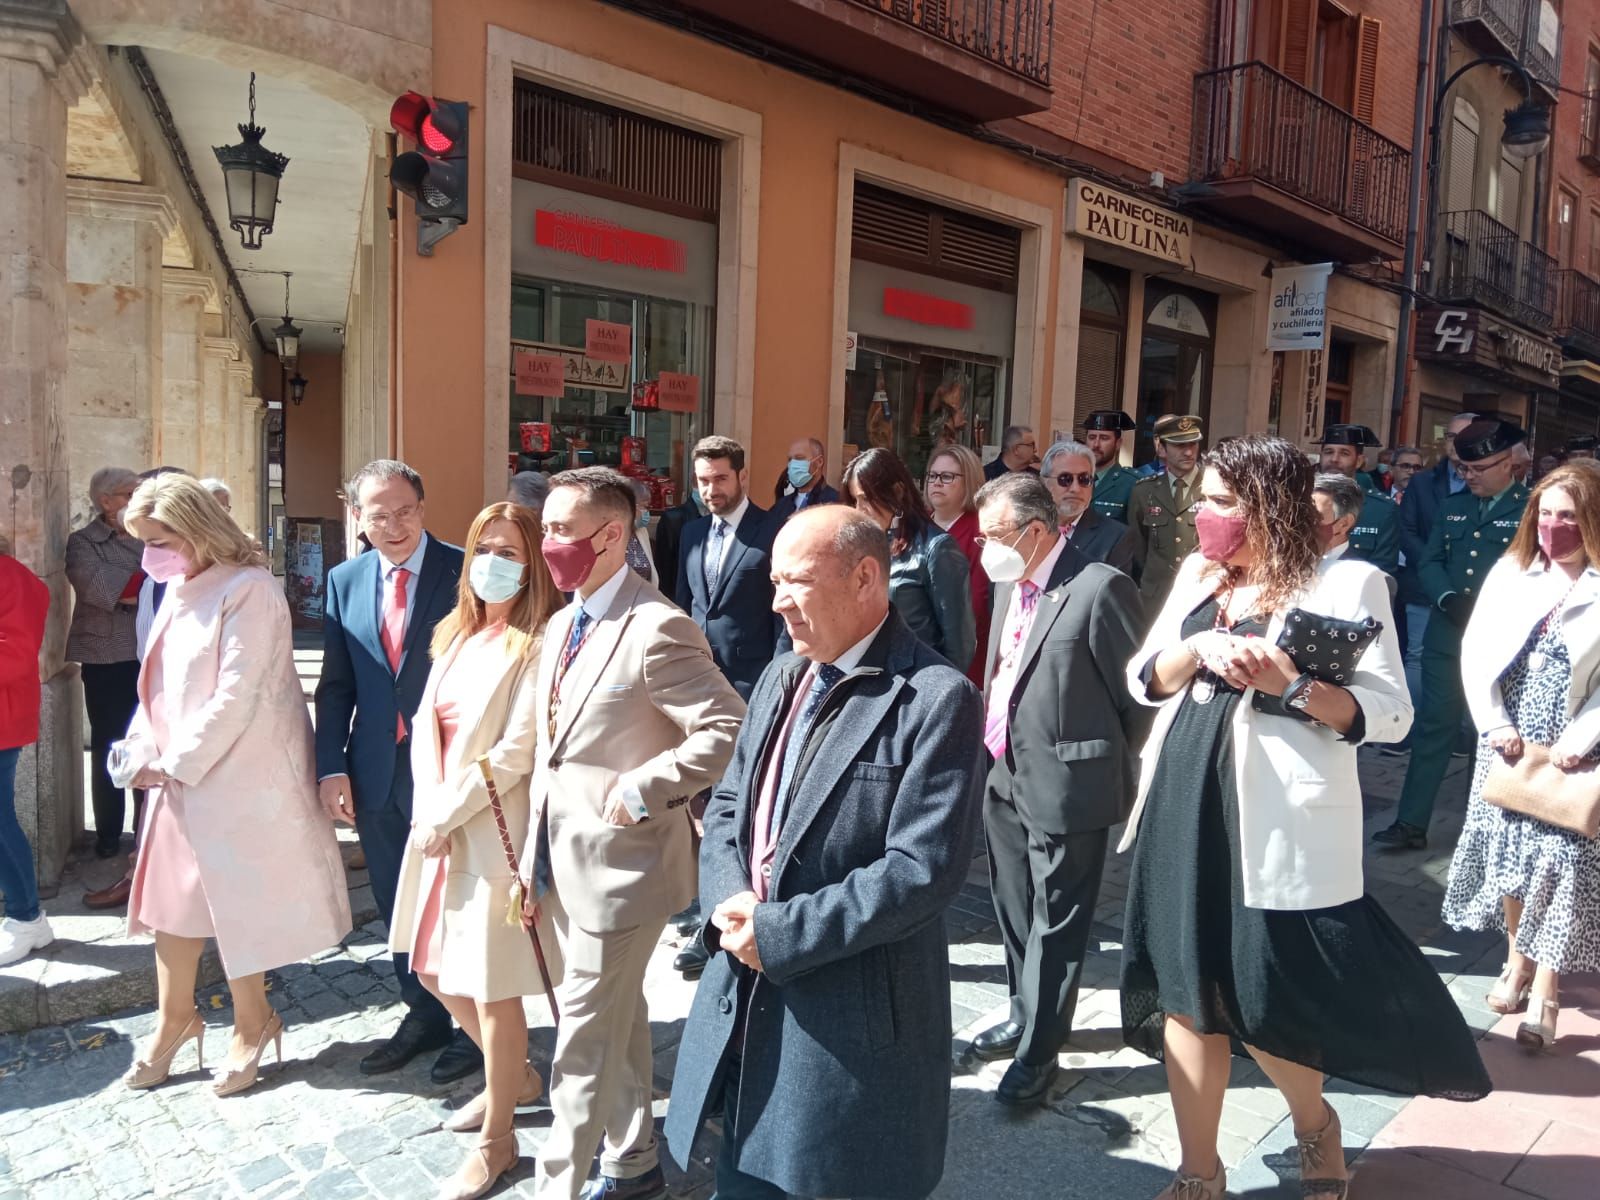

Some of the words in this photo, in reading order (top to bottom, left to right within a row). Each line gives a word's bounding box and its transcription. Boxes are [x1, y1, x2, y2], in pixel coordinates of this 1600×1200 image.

[1080, 186, 1189, 237] CARNECERIA
[1086, 209, 1182, 259] PAULINA
[553, 224, 658, 271] PAULINA
[1290, 307, 1324, 317] afilados
[1272, 322, 1278, 330] y
[597, 327, 620, 340] HAY
[528, 360, 552, 374] HAY
[668, 378, 688, 390] HAY
